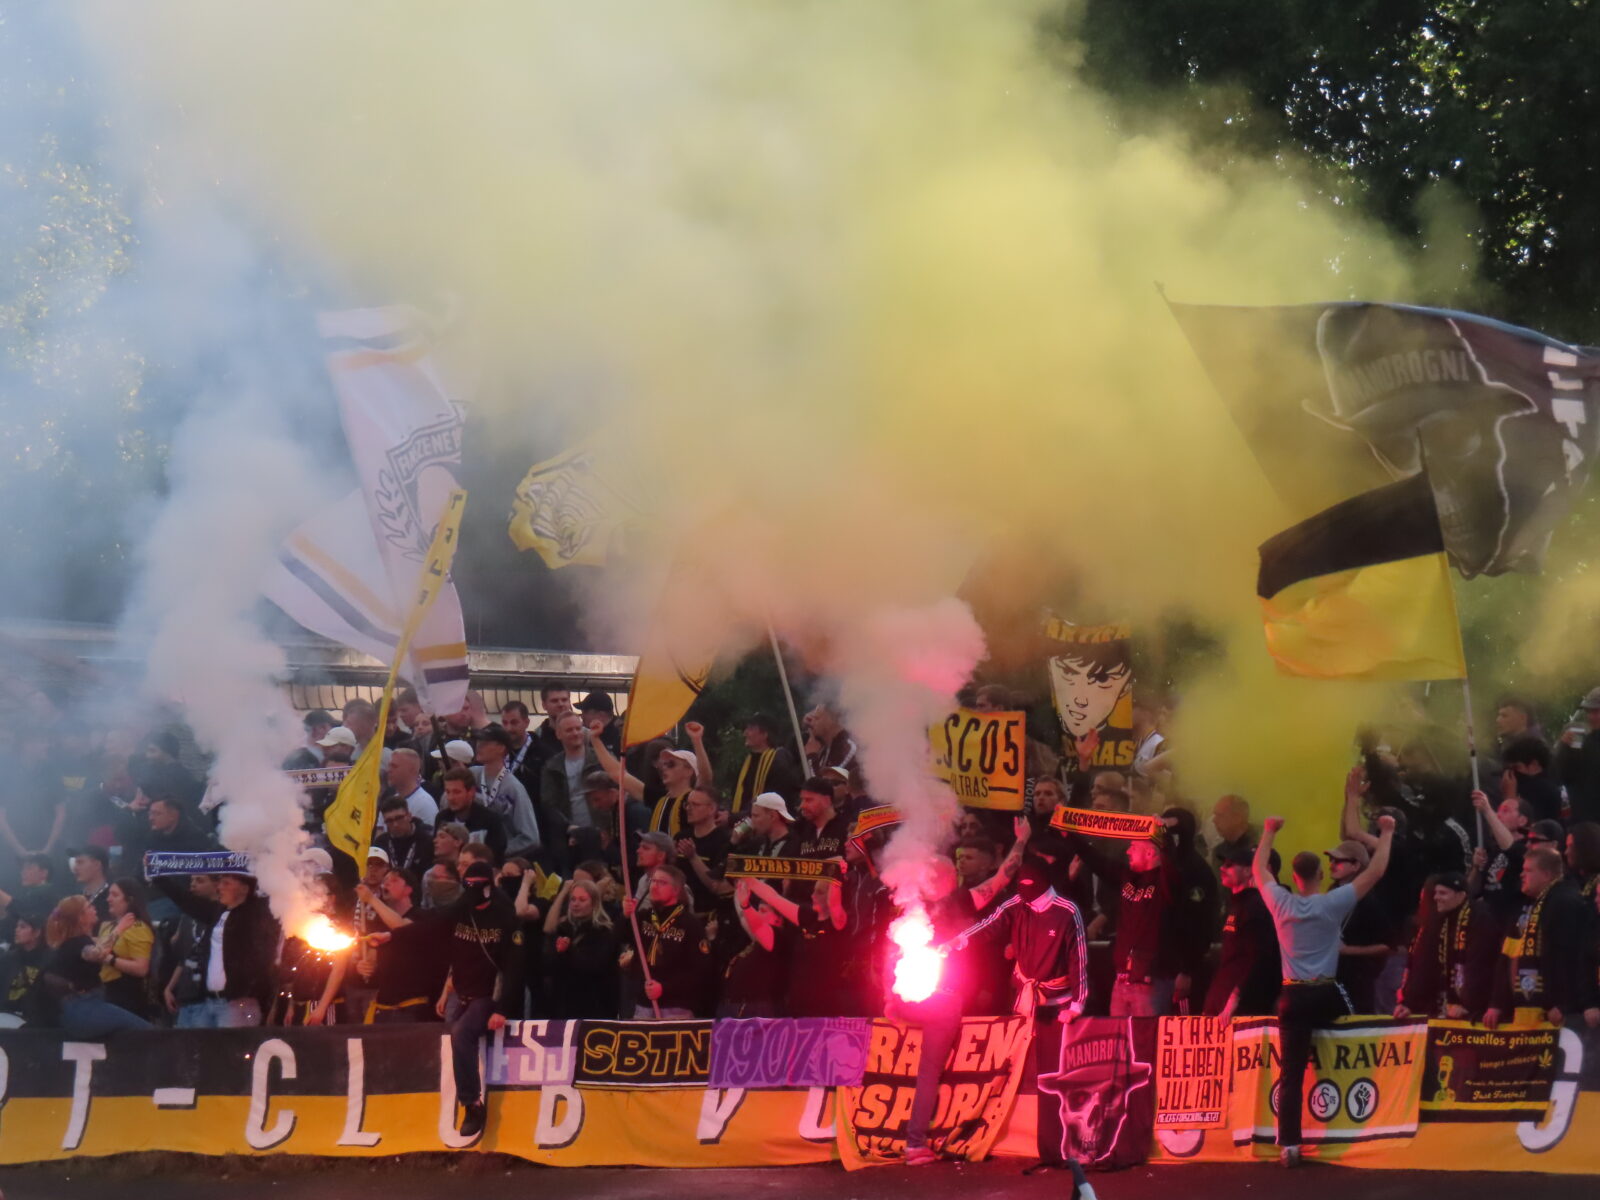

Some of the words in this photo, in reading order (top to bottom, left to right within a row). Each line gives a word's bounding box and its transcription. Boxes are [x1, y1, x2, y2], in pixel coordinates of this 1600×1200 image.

[1062, 810, 1152, 832] RASENSPORTGUERILLA
[744, 858, 791, 873] ULTRAS
[796, 860, 823, 875] 1905
[1163, 1016, 1226, 1046] STARK
[1435, 1030, 1463, 1046] Los
[1466, 1033, 1506, 1046] cuellos
[582, 1028, 711, 1077] SBTN
[712, 1016, 827, 1085] 1907
[1161, 1046, 1225, 1078] BLEIBEN
[1237, 1042, 1322, 1072] BANA
[1334, 1040, 1414, 1070] RAVAL
[1159, 1078, 1224, 1110] JULIAN
